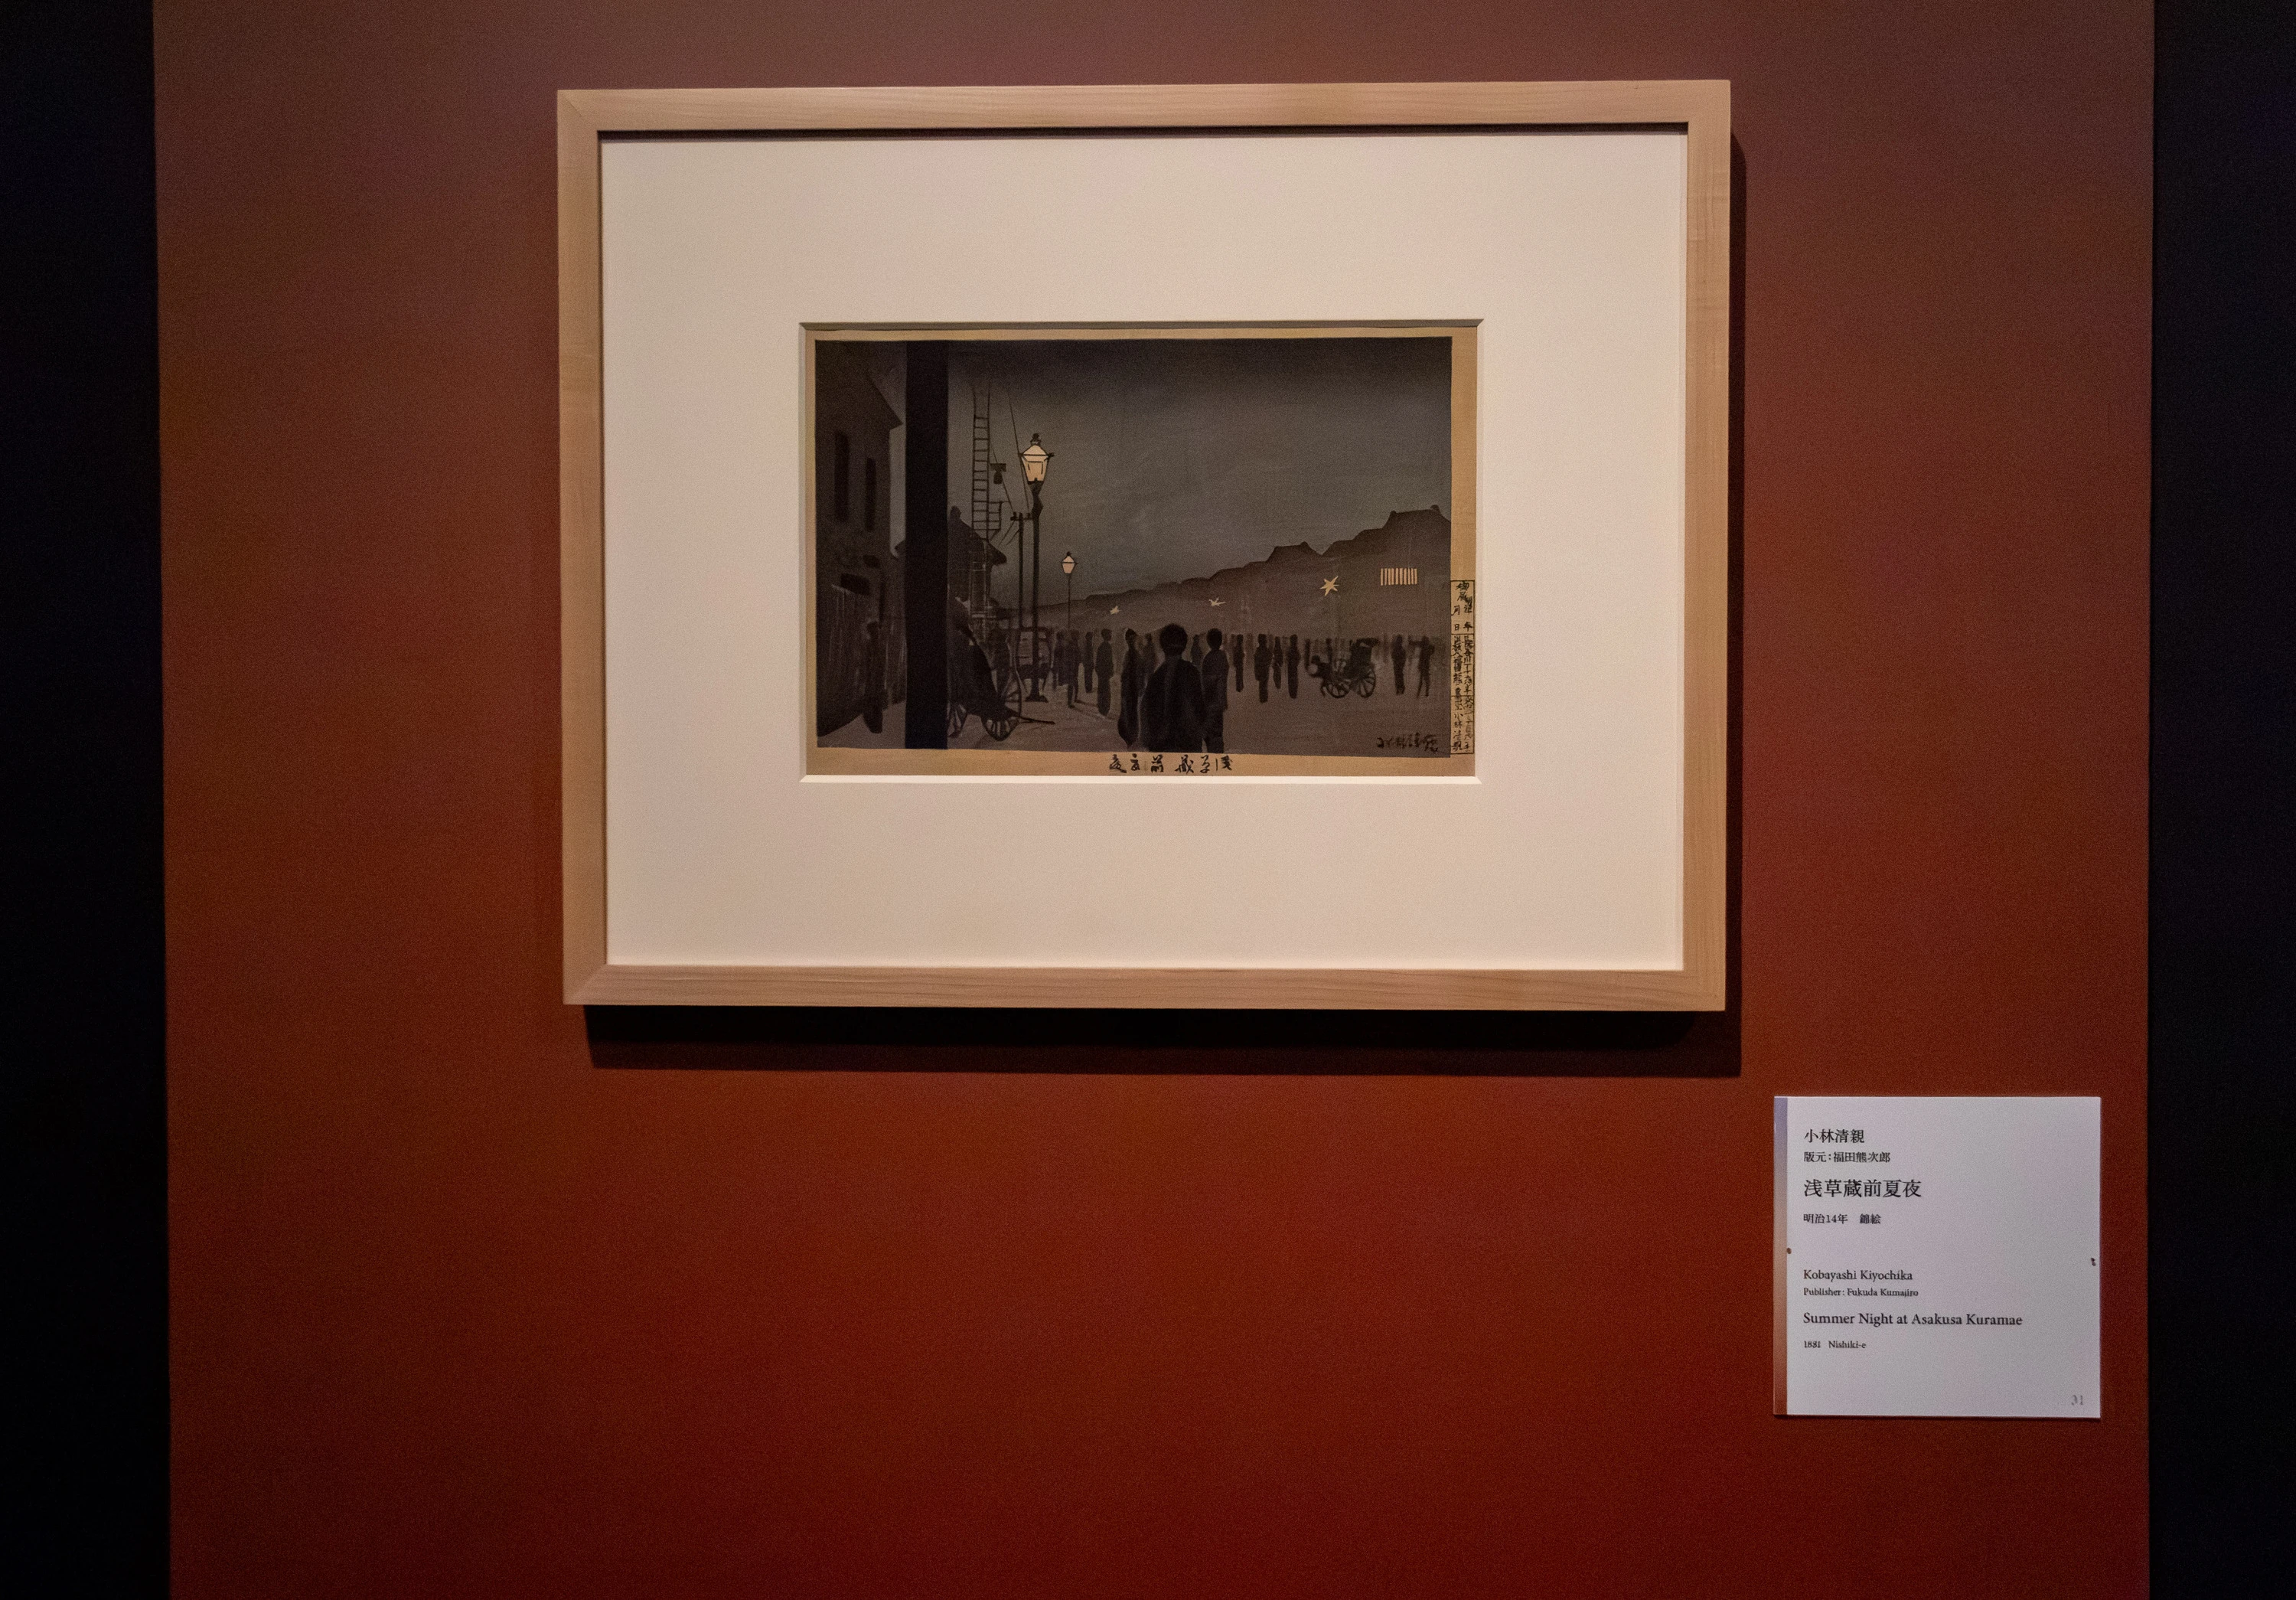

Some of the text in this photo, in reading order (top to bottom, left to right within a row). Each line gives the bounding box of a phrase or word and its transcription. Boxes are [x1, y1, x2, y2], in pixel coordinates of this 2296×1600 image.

[1804, 1128, 1865, 1144] 小林清親
[1803, 1178, 1923, 1199] 浅草蔵前夏夜
[1802, 1213, 1849, 1225] 明治14年
[1803, 1269, 1913, 1283] Kobayashi Kiyochika
[1803, 1287, 1845, 1297] Publisher:
[1847, 1287, 1878, 1297] Fukuda
[1802, 1311, 2024, 1328] Summer Night at Asakusa Kuramae
[1828, 1340, 1867, 1349] Nishiki-e
